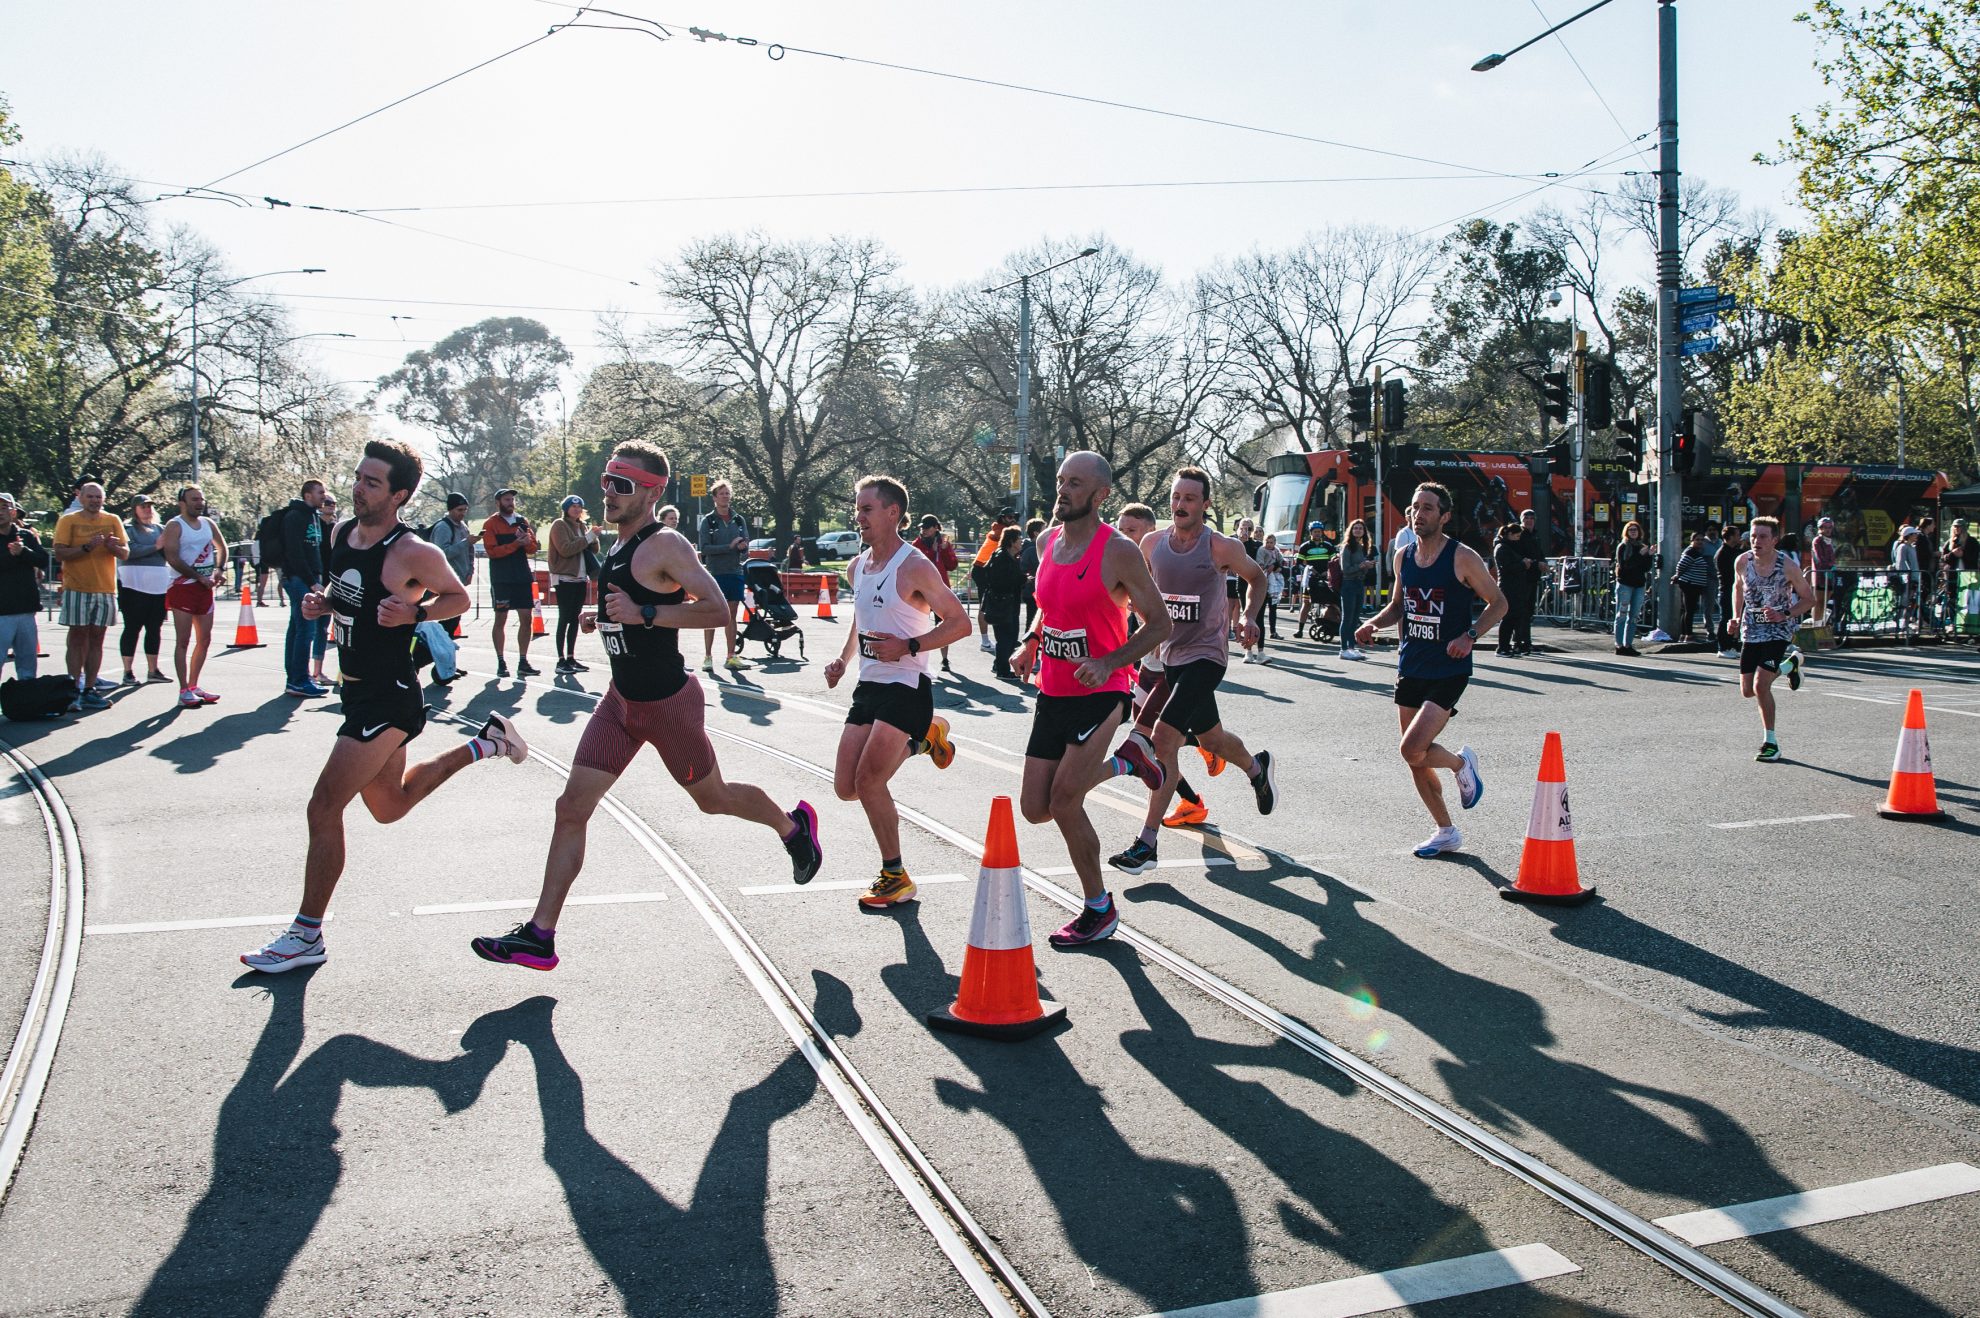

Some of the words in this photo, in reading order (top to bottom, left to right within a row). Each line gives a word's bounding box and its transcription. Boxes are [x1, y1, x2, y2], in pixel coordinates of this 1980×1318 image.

[1402, 586, 1446, 600] LOVE
[1406, 600, 1444, 614] RUN
[1408, 622, 1434, 640] 24796
[1044, 636, 1080, 658] 24730
